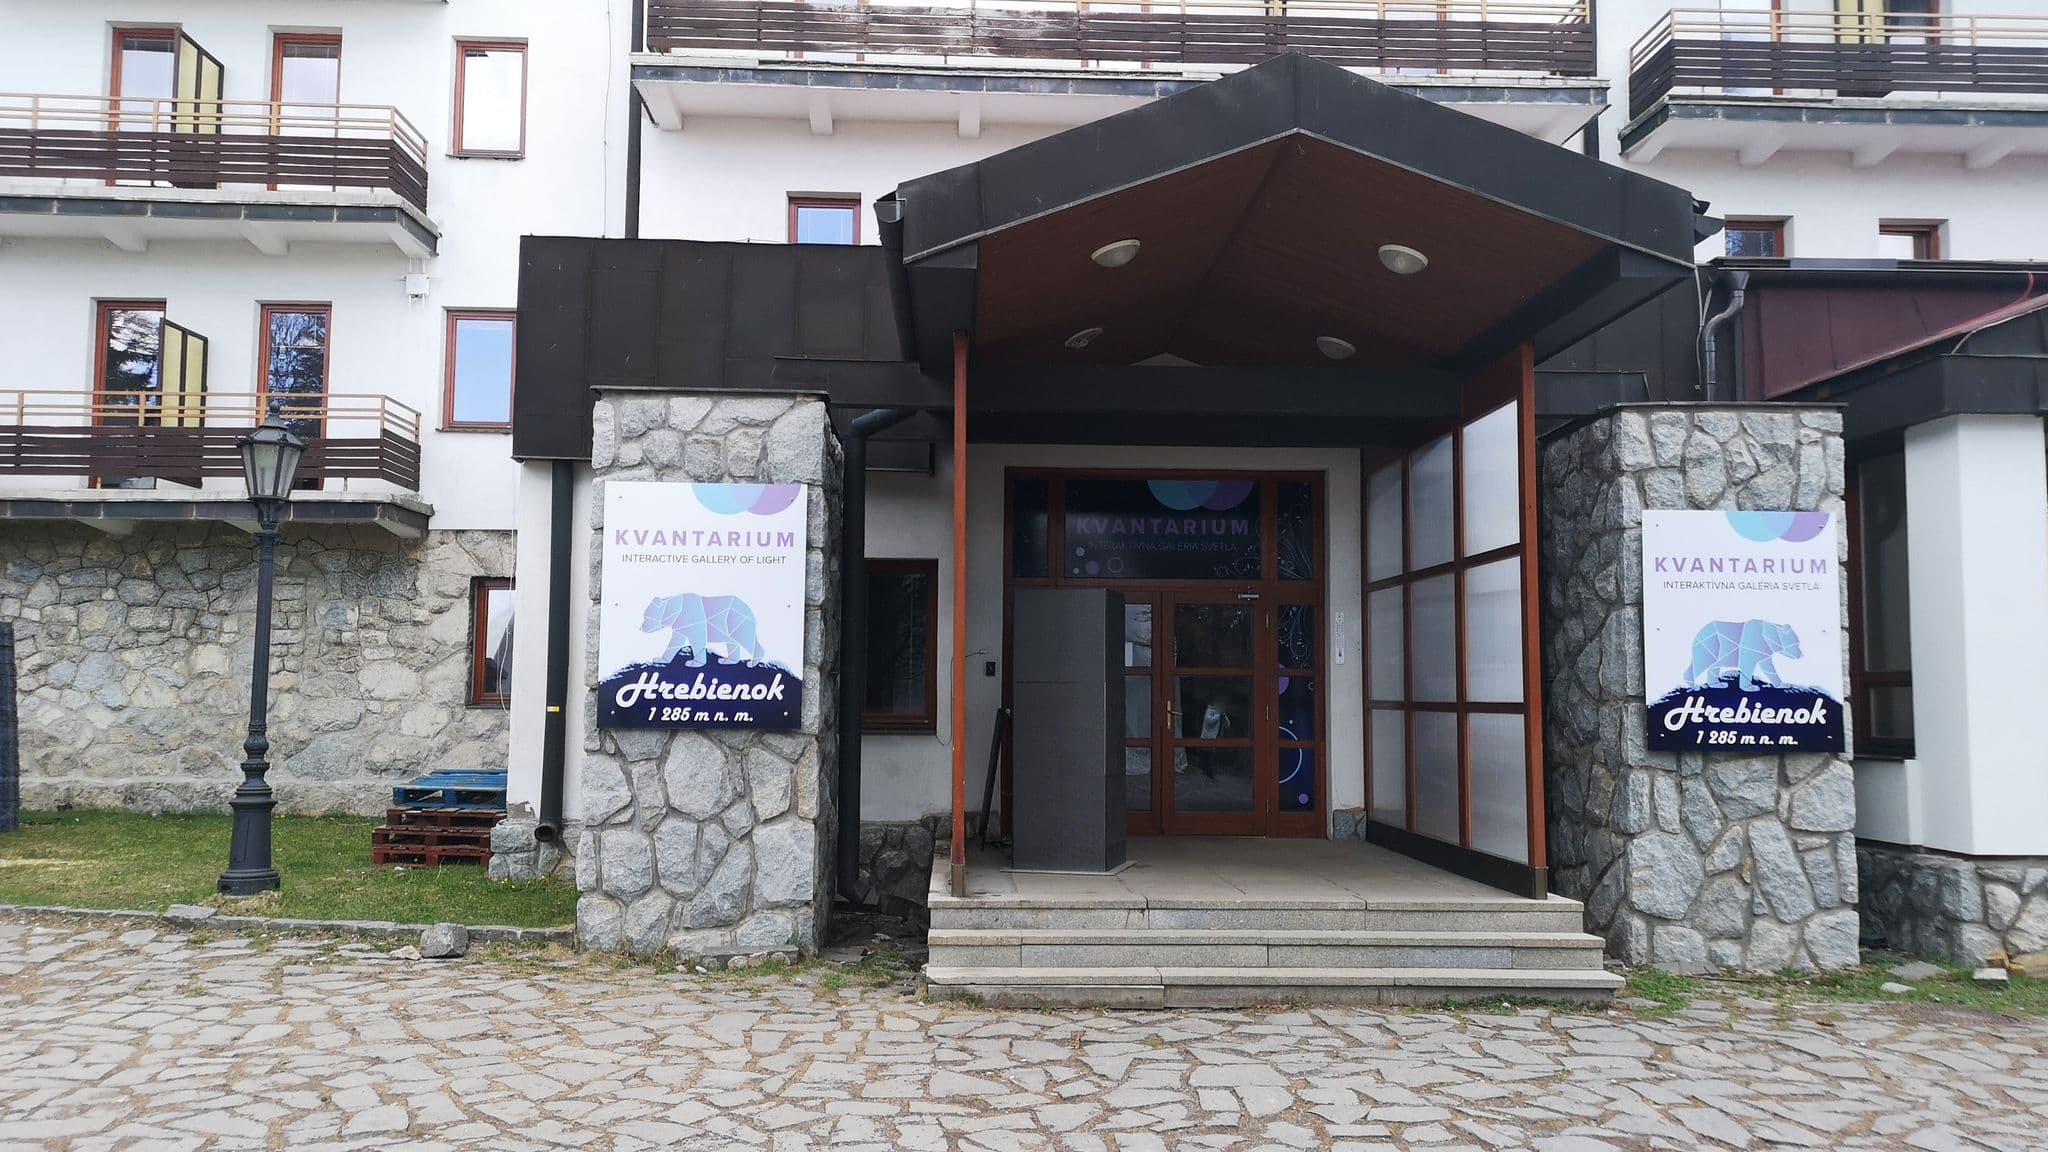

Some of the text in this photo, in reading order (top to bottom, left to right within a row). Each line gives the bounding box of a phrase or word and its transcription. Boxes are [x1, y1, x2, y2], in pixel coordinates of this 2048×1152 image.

[1075, 519, 1250, 536] KVANTARIUM
[615, 529, 795, 548] KVANTARIUM
[621, 554, 787, 565] INTERACTIVE GALLERY OF LIGHT
[1654, 557, 1828, 574] KVANTARIUM
[1782, 582, 1820, 591] SVETLA
[615, 671, 785, 708] Hrebienok
[648, 707, 754, 722] 1 285 m n. m.
[1664, 696, 1828, 731] Hrebienok
[1696, 731, 1799, 745] 1 285 m n. m.
